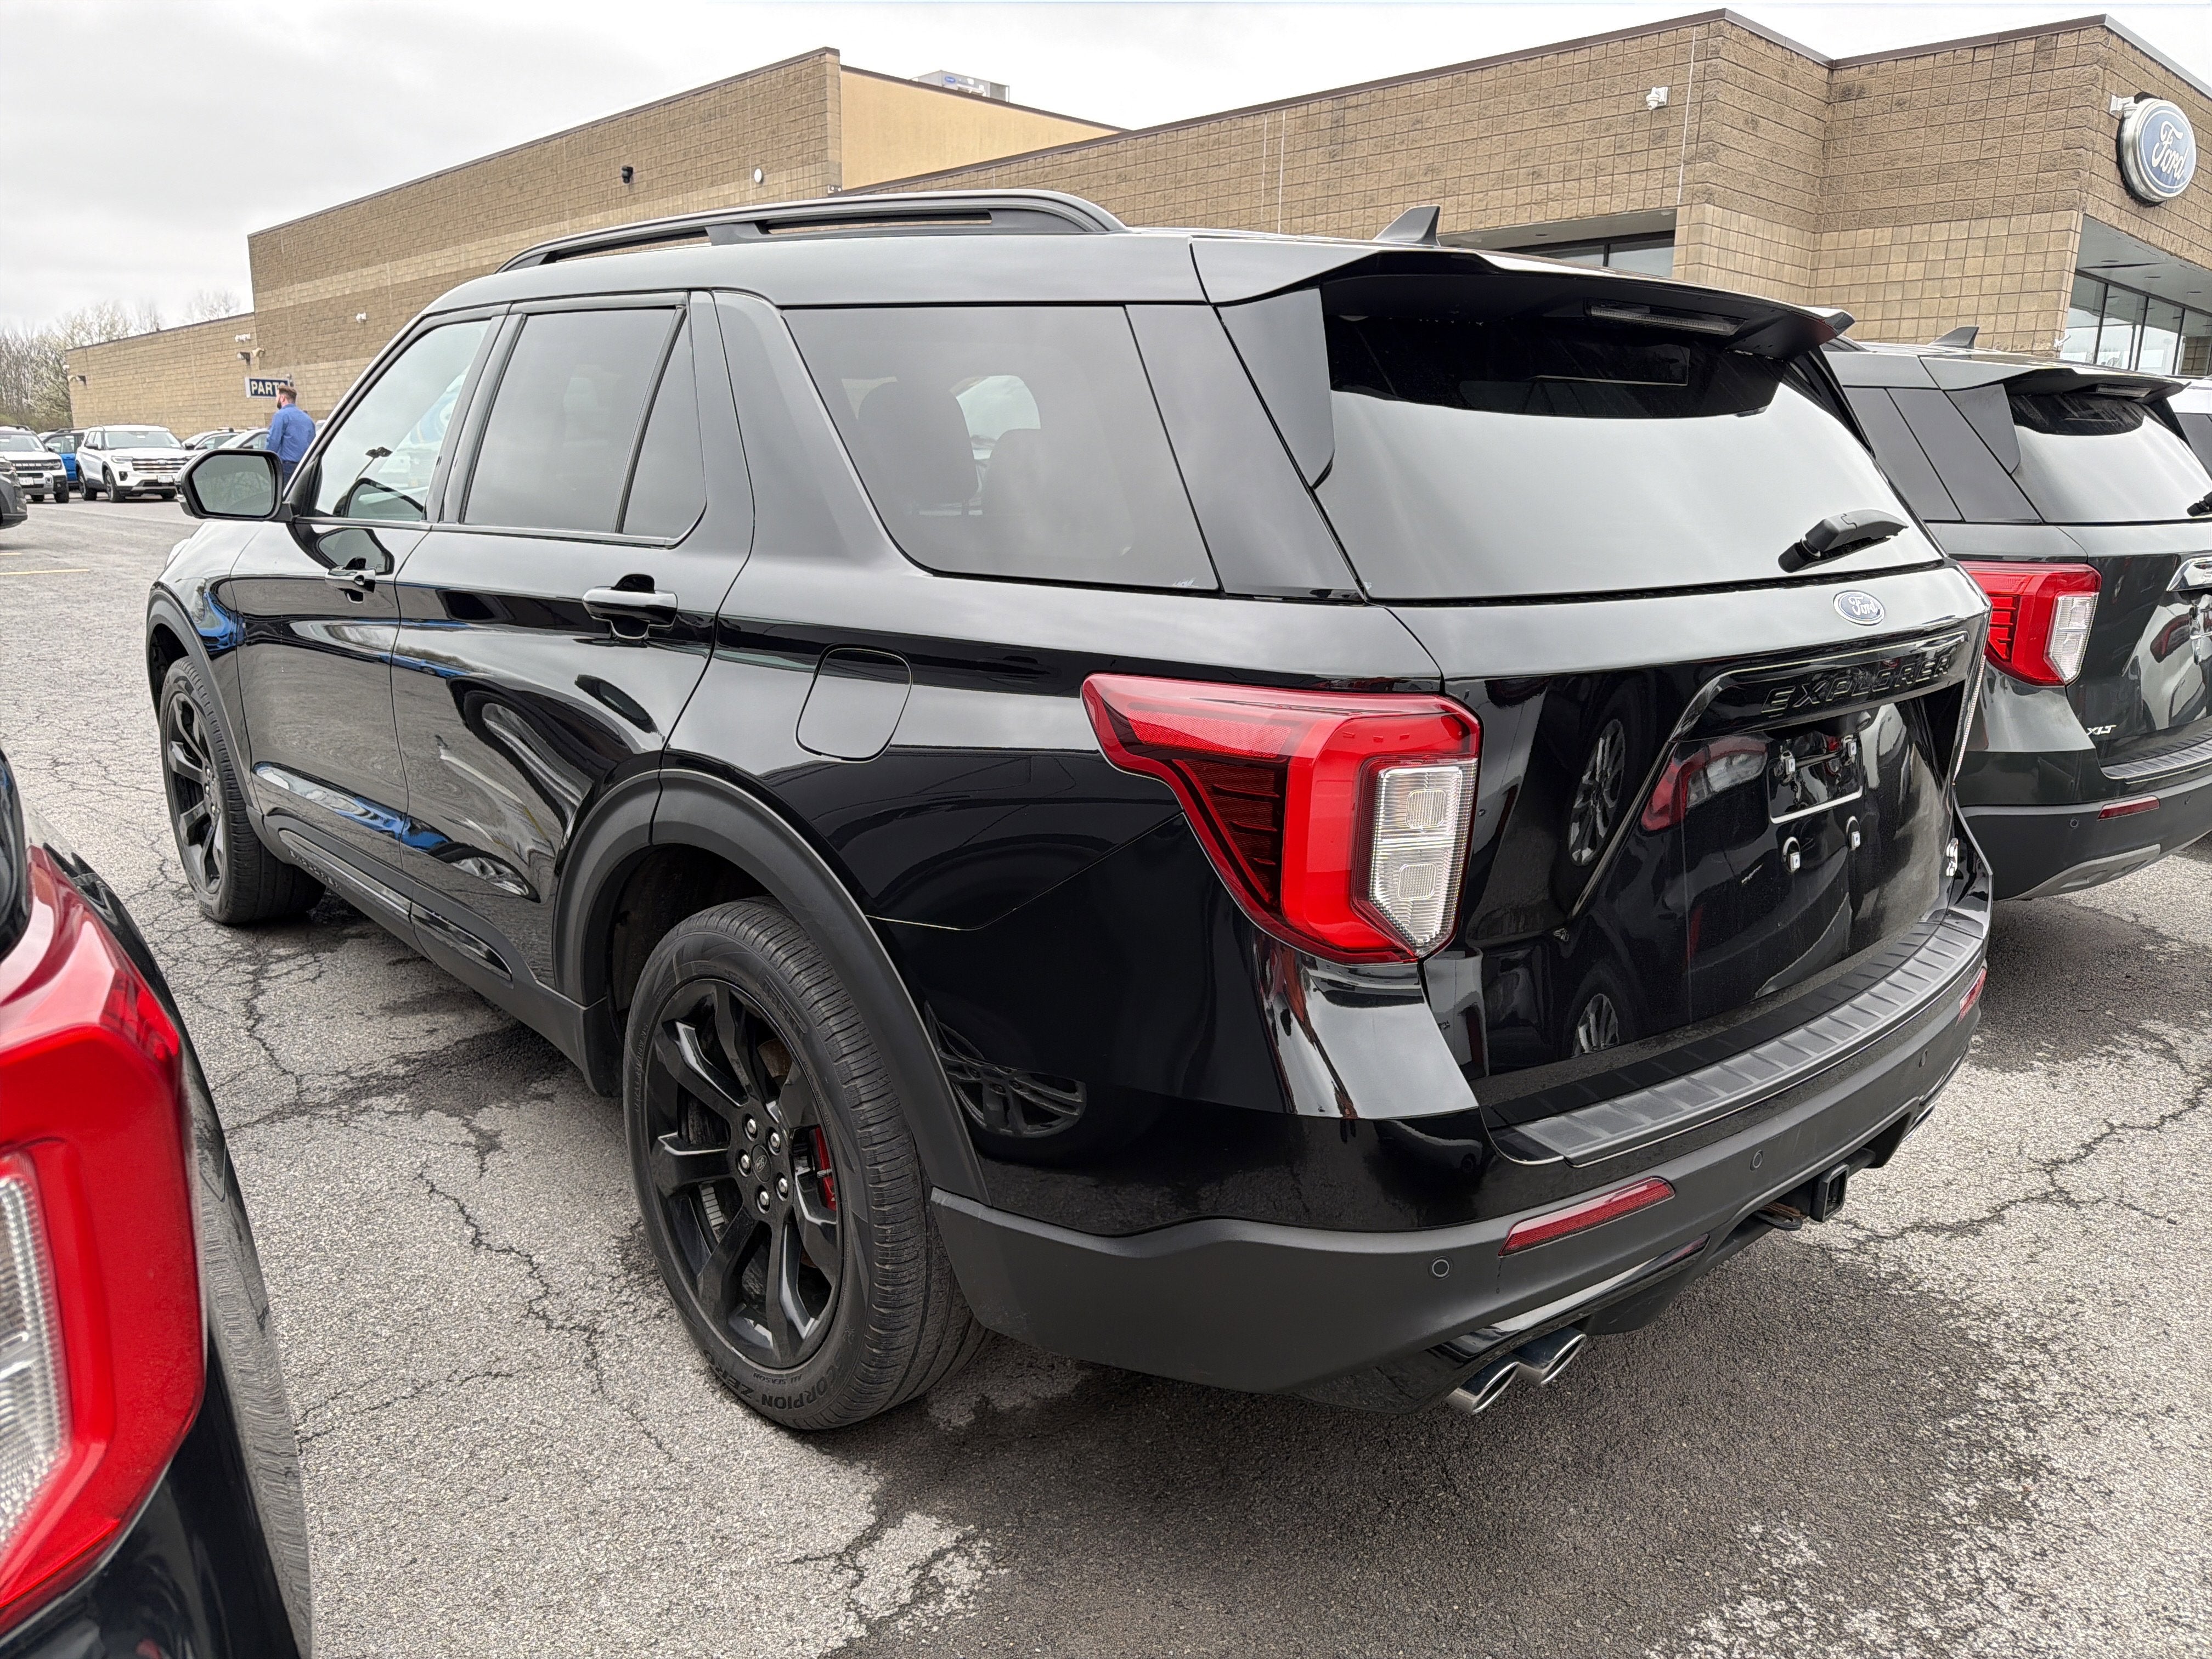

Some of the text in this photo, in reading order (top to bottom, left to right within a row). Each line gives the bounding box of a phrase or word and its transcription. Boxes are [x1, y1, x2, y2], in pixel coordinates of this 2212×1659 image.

[2151, 121, 2189, 180] Ford
[1848, 596, 1878, 616] Ford
[1761, 653, 1952, 714] EXPLORER
[2086, 724, 2117, 736] XLT
[702, 1349, 754, 1399] ZERO
[753, 1372, 787, 1385] SEASON
